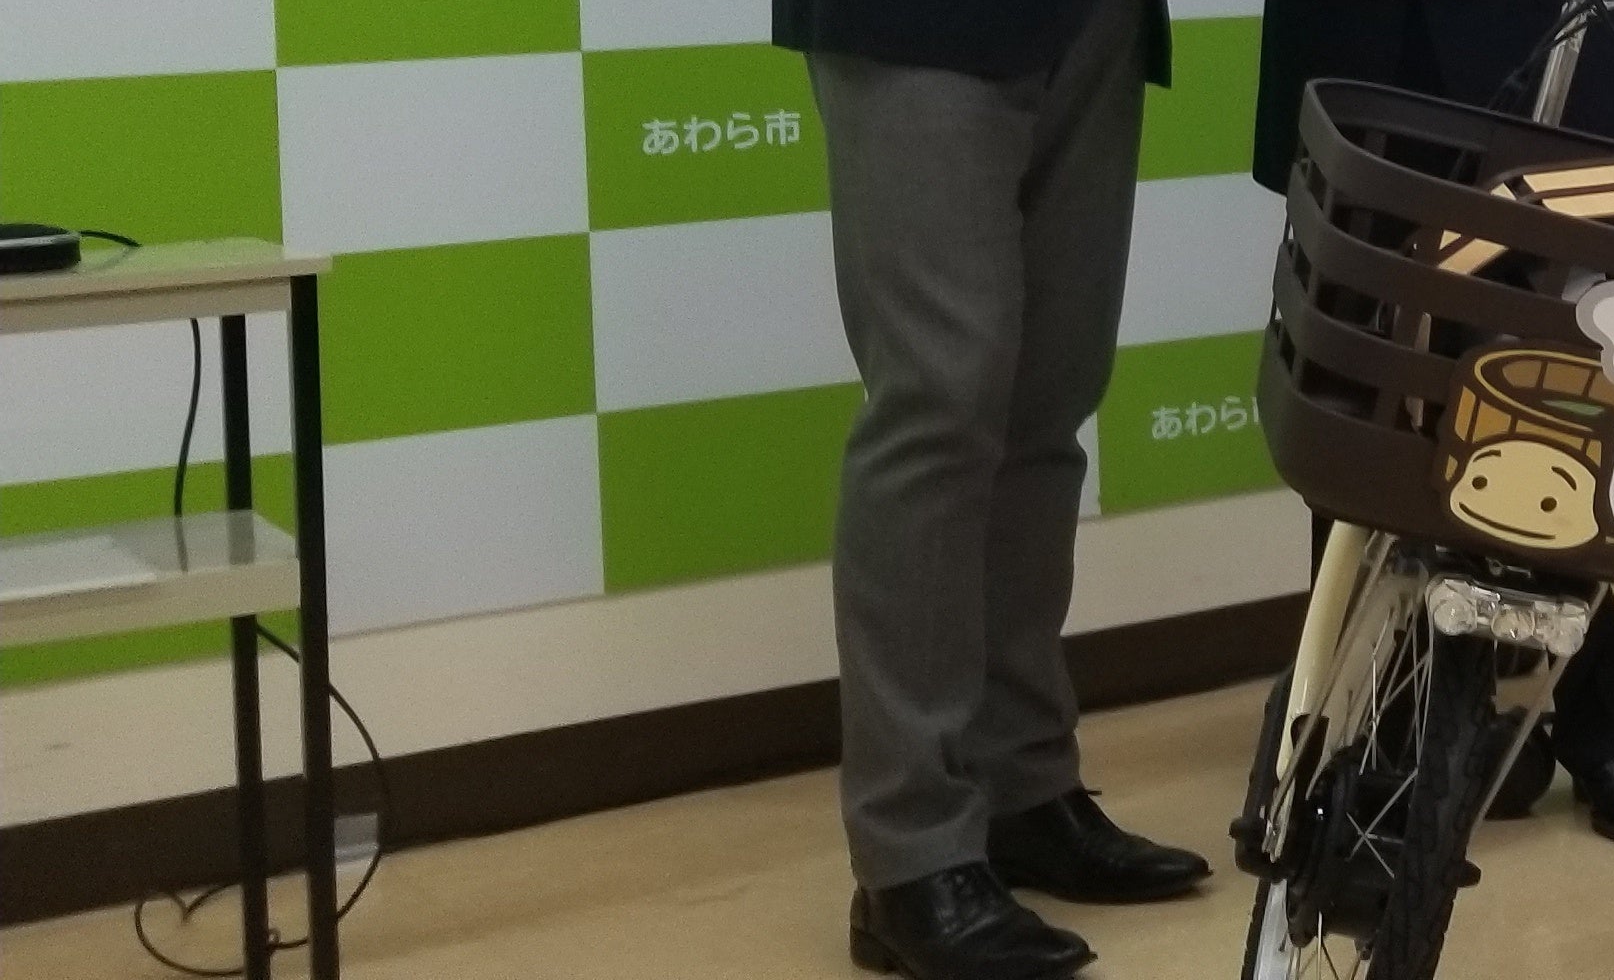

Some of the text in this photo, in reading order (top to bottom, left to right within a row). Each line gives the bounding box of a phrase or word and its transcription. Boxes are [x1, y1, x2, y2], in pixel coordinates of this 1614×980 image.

[641, 110, 802, 156] あわら市
[1152, 395, 1259, 440] あわら
